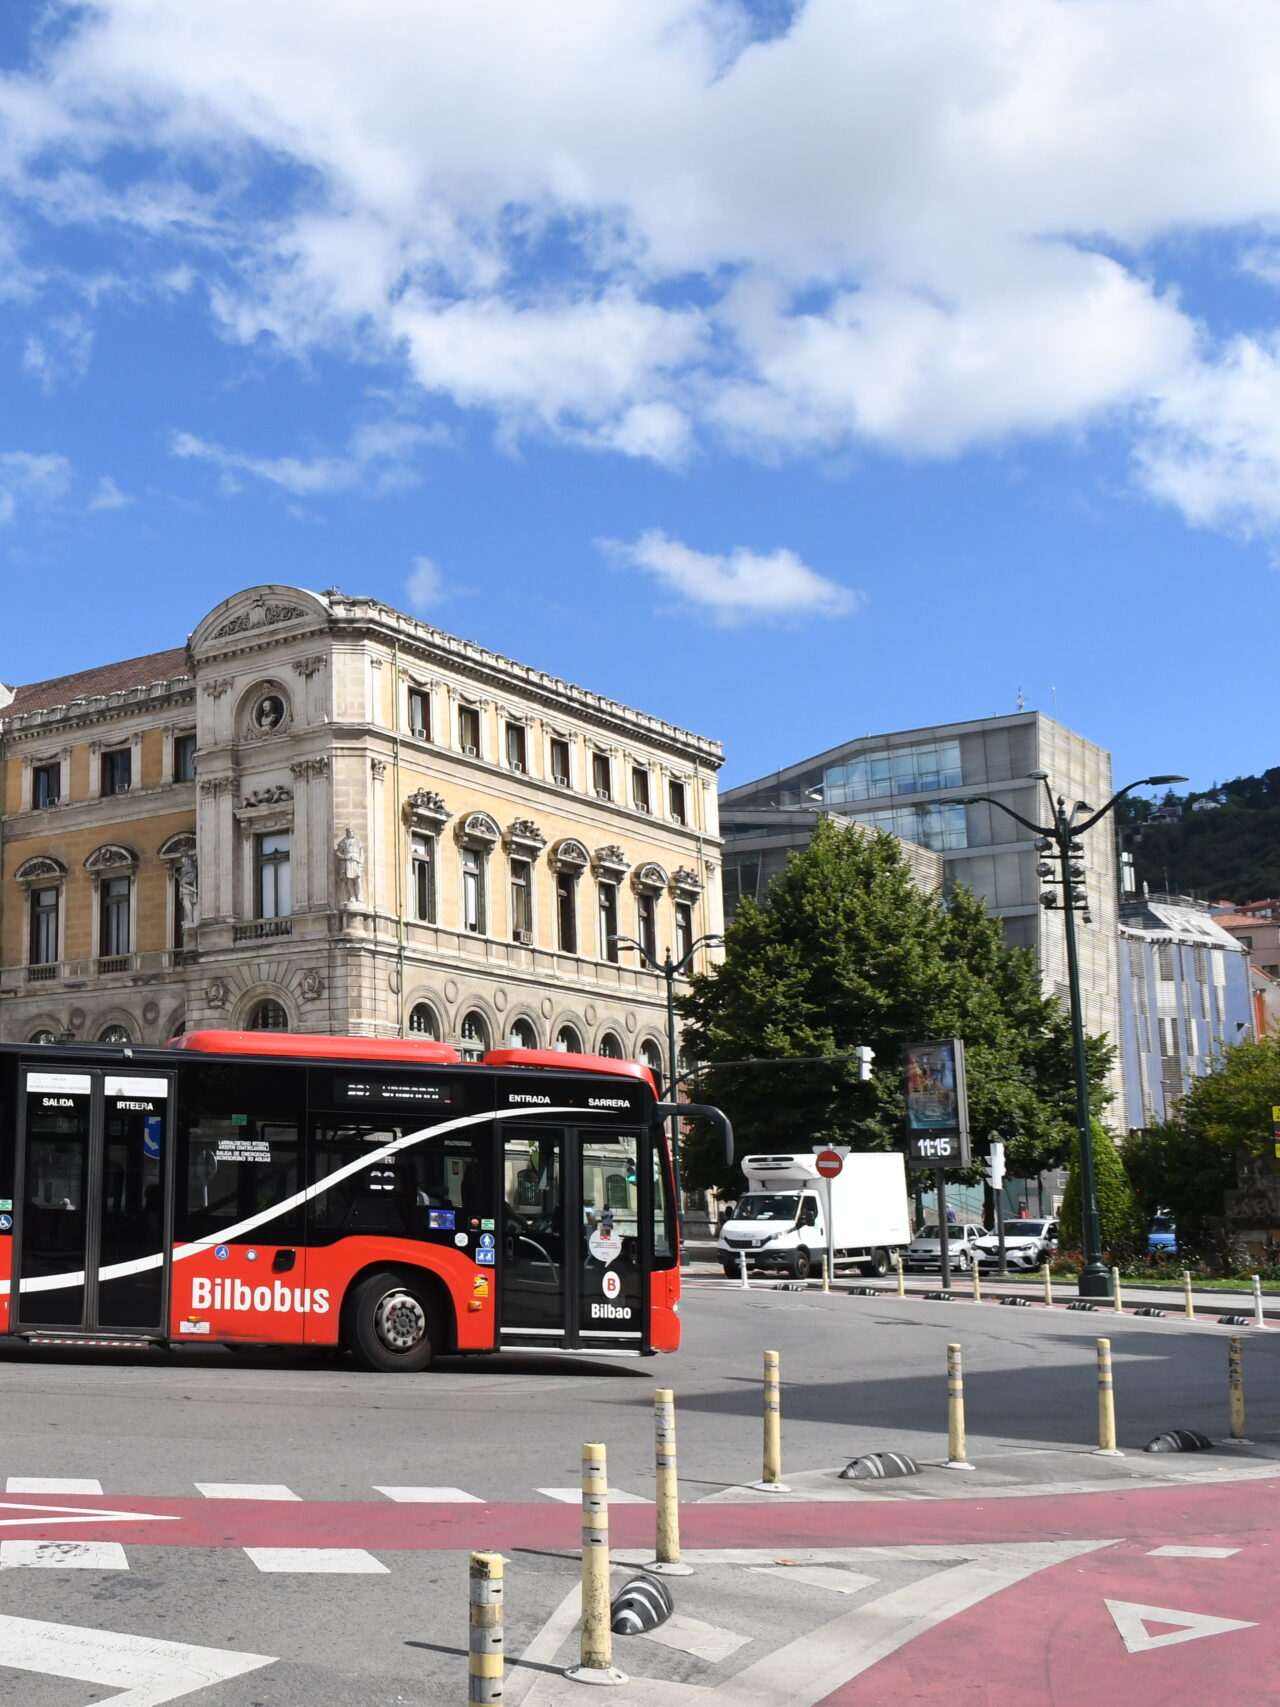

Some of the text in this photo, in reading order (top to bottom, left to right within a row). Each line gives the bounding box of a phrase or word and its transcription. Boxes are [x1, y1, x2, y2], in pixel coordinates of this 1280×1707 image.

[42, 1097, 74, 1107] SALIDA
[508, 1094, 551, 1104] ENTRADA
[588, 1098, 631, 1108] SARRERA
[116, 1101, 154, 1111] IRTEERA
[917, 1138, 951, 1156] 11:15
[607, 1278, 616, 1291] B
[191, 1277, 330, 1313] Bilbobus
[591, 1303, 632, 1319] Bilbao
